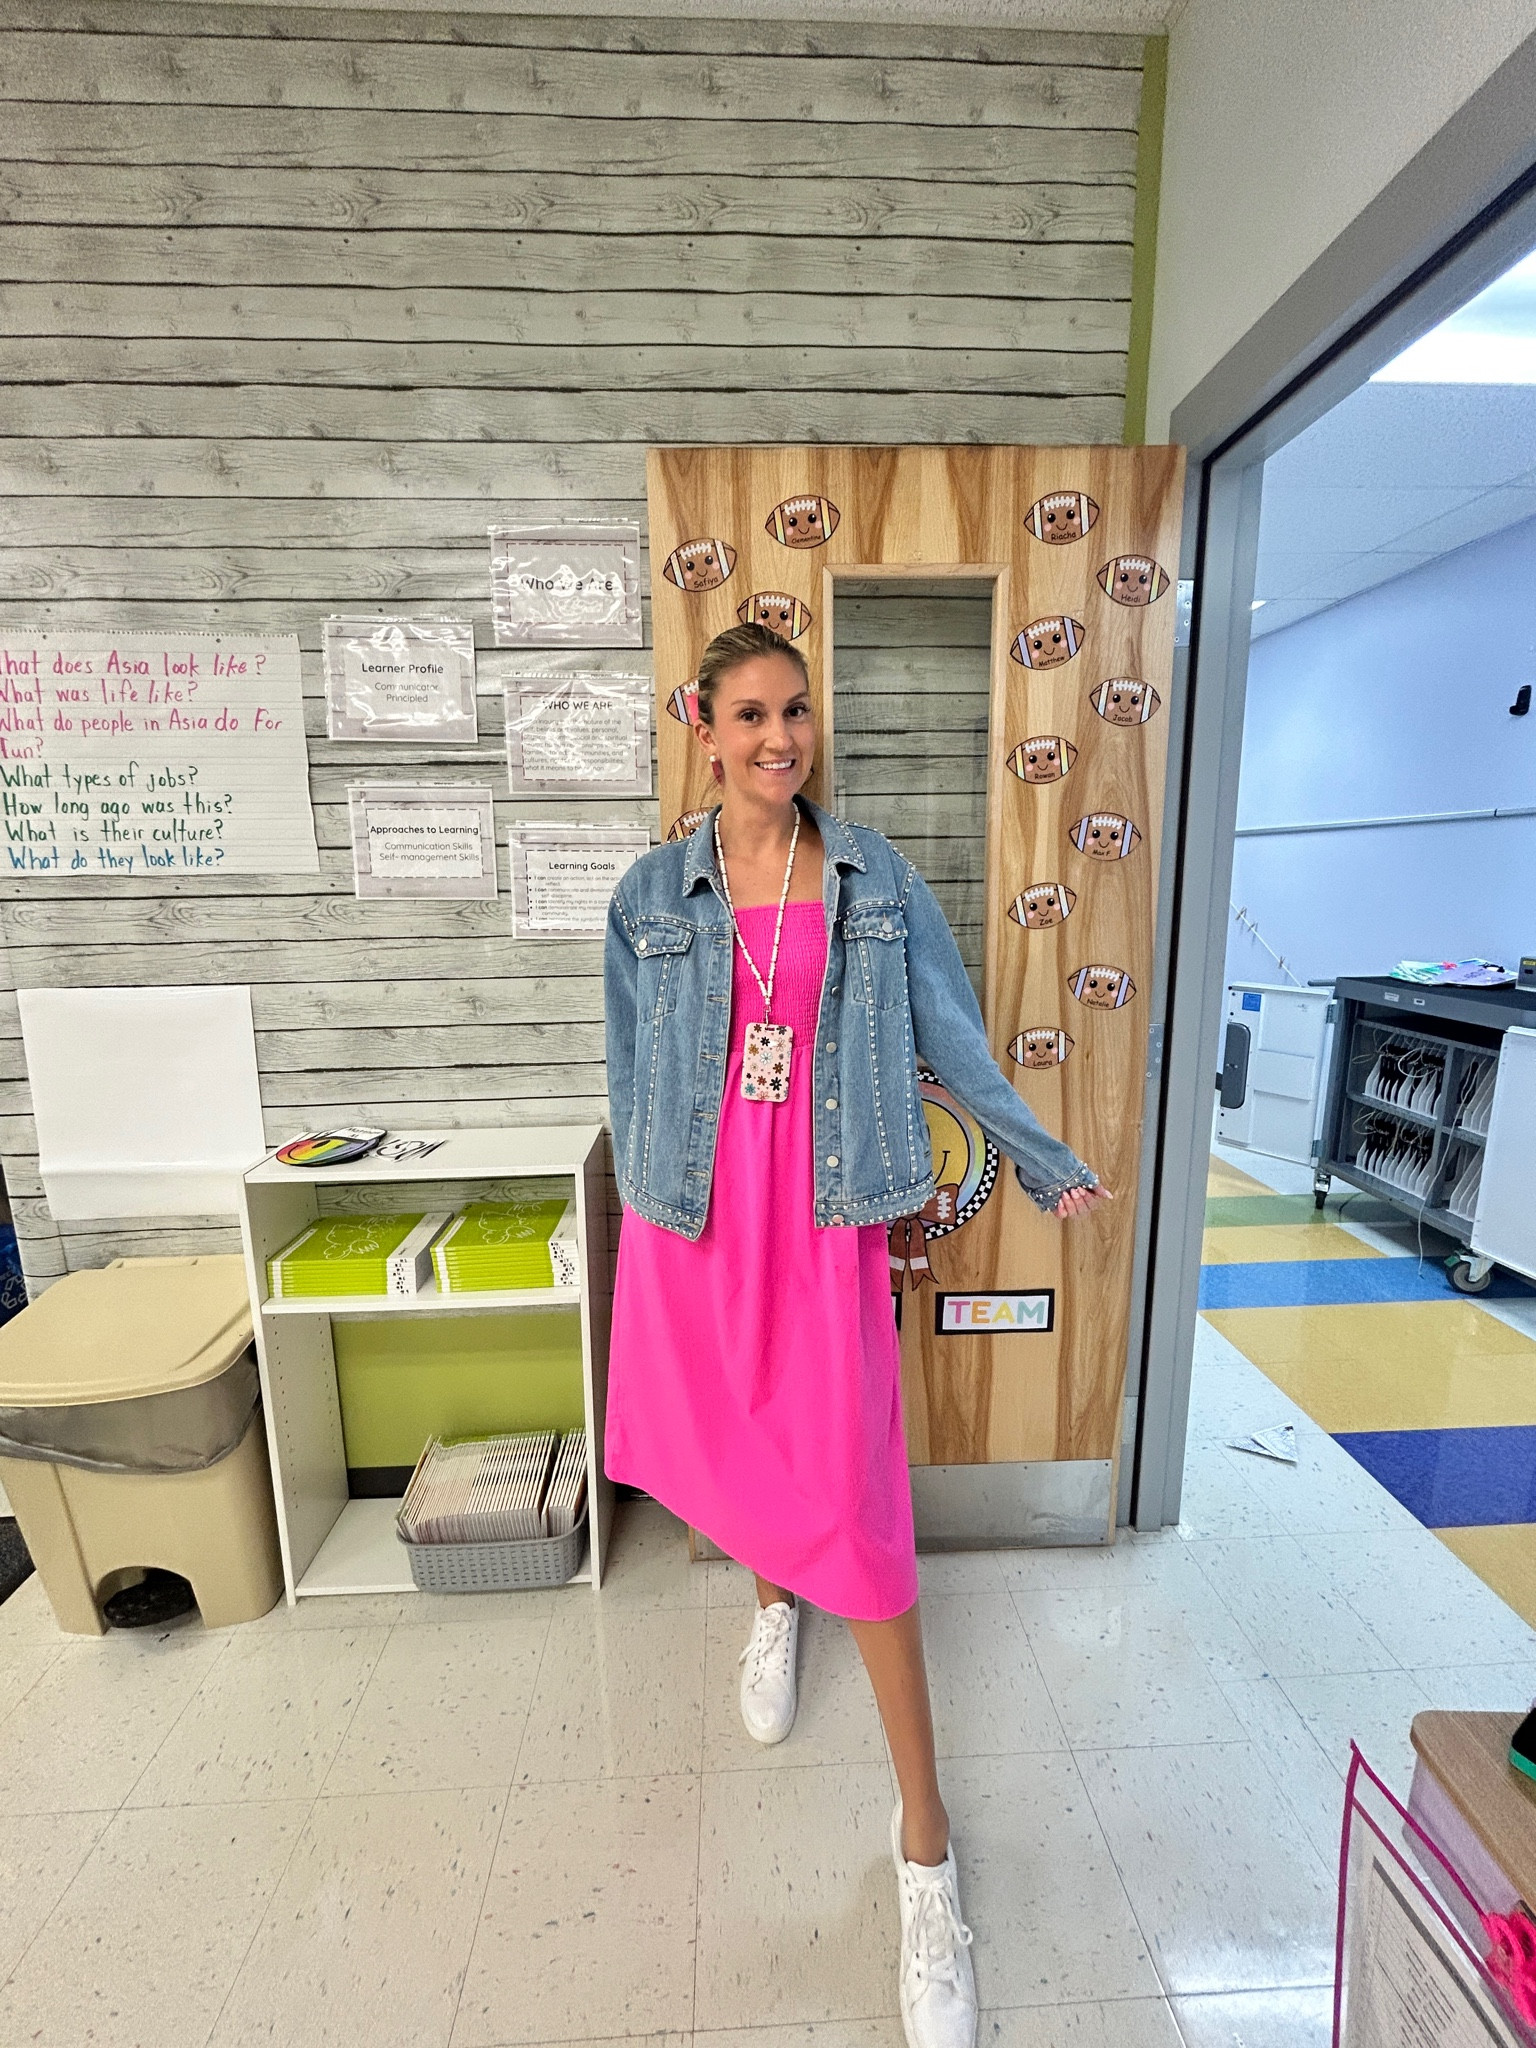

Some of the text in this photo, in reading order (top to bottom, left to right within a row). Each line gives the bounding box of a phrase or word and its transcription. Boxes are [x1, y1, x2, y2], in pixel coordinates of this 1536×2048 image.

[693, 576, 719, 589] Safiya
[1121, 593, 1141, 603] Heidi
[0, 650, 41, 675] hat
[53, 651, 93, 675] does
[107, 650, 150, 675] Asia
[164, 652, 200, 676] look
[1038, 655, 1066, 667] Matthew
[362, 663, 444, 674] Learner Profile
[56, 687, 90, 701] was
[101, 678, 138, 704] life
[148, 680, 199, 704] like?
[374, 682, 439, 692] Communicator
[386, 694, 429, 703] Principled
[573, 701, 589, 711] WE
[592, 701, 613, 711] ARE
[54, 708, 73, 731] do
[81, 708, 133, 738] people
[144, 716, 160, 731] in
[168, 707, 208, 731] Asia
[214, 707, 239, 731] do
[254, 707, 284, 731] For
[1112, 713, 1133, 723] Jacob
[0, 760, 199, 793] What types of jobs?
[3, 791, 233, 822] How long ago was this?
[5, 818, 225, 844] What is their culture?
[370, 825, 479, 836] Approaches to Learning
[384, 842, 474, 851] Communication Skills
[7, 844, 226, 873] What do they look like?
[379, 853, 480, 863] Self- management Skills
[548, 862, 616, 872] Learning Goals
[948, 1301, 1045, 1324] TEAM
